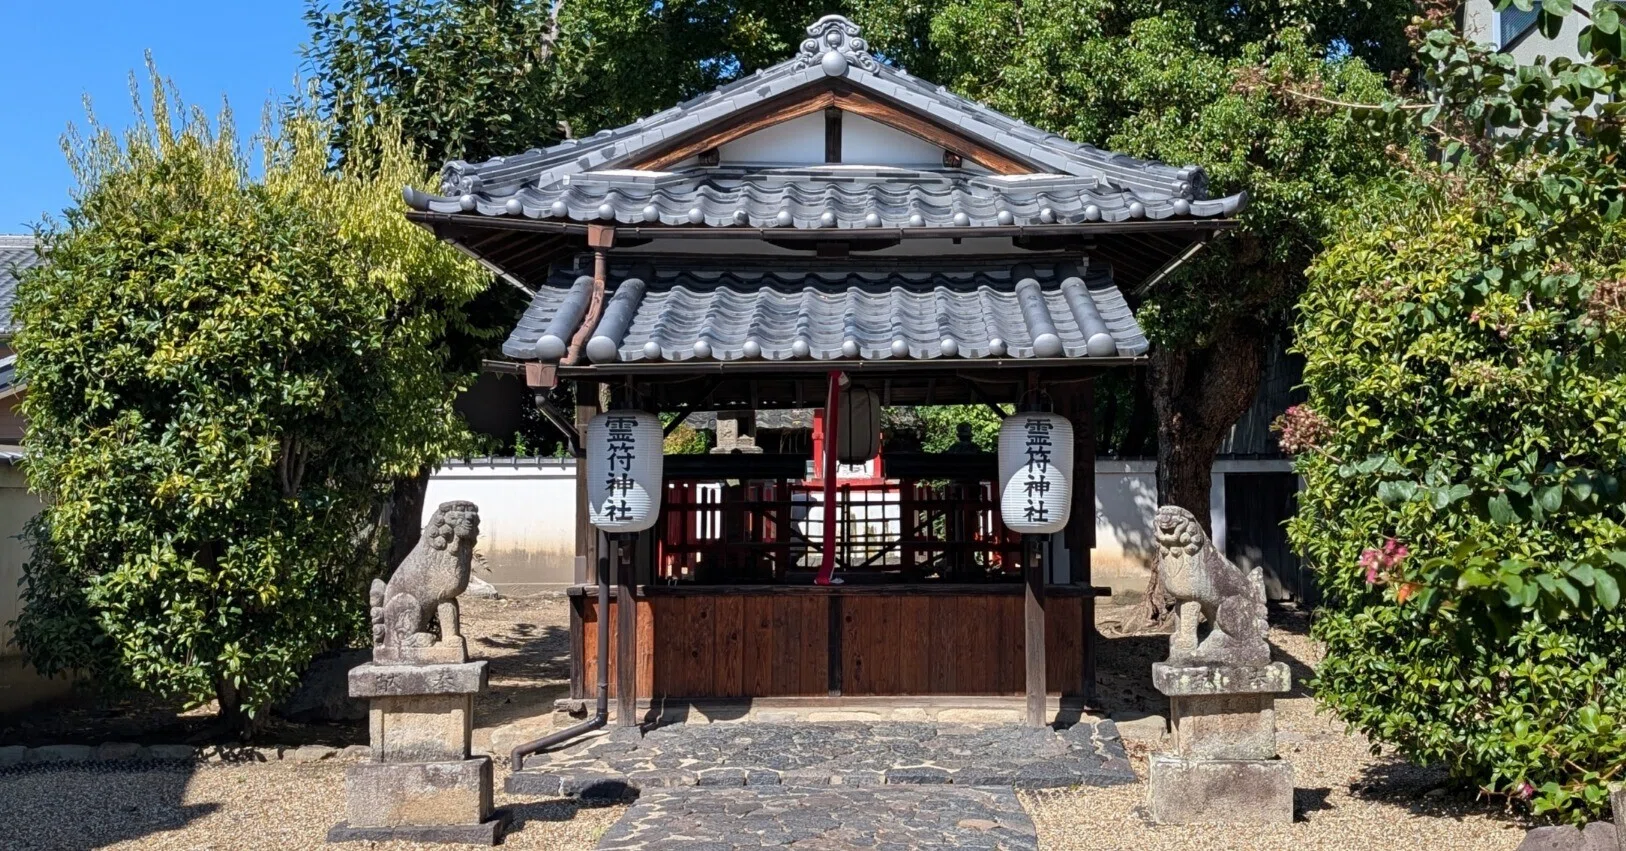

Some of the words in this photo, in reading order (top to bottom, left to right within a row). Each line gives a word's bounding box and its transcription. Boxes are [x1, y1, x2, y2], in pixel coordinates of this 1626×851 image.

[605, 416, 638, 522] 霊符神社
[1023, 418, 1053, 523] 霊符神社
